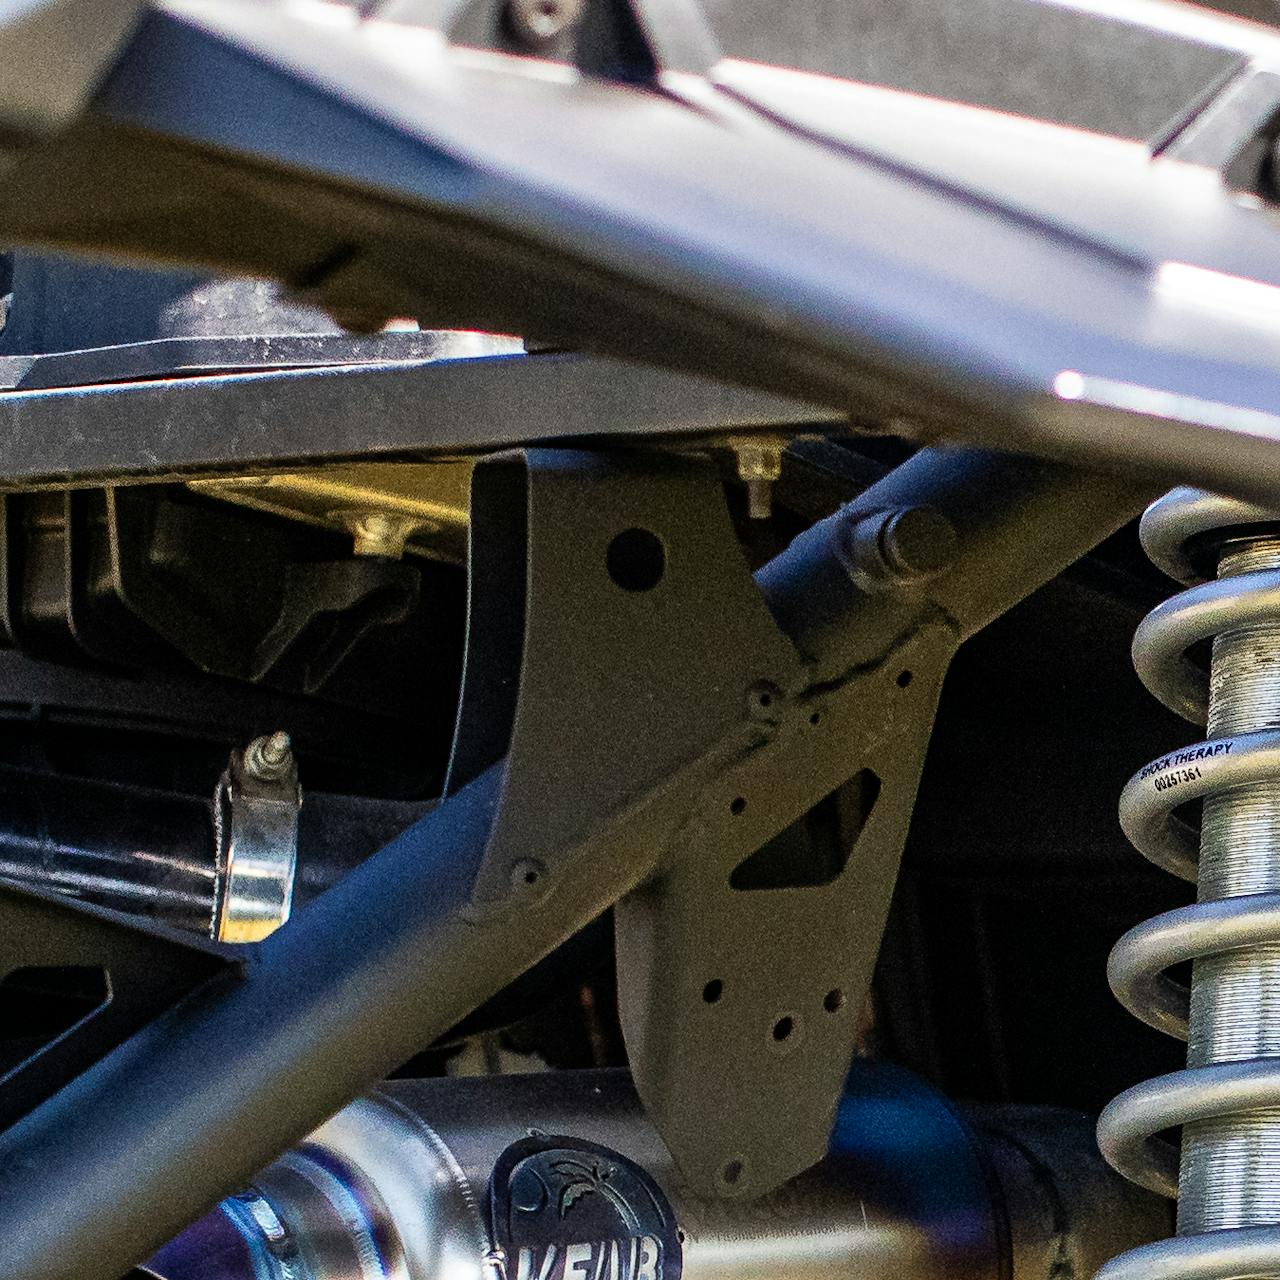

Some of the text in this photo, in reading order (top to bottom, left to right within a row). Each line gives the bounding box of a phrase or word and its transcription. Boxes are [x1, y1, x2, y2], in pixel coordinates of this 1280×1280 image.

[1140, 742, 1233, 780] SHOCK THERAPY
[1154, 766, 1202, 792] 00257361
